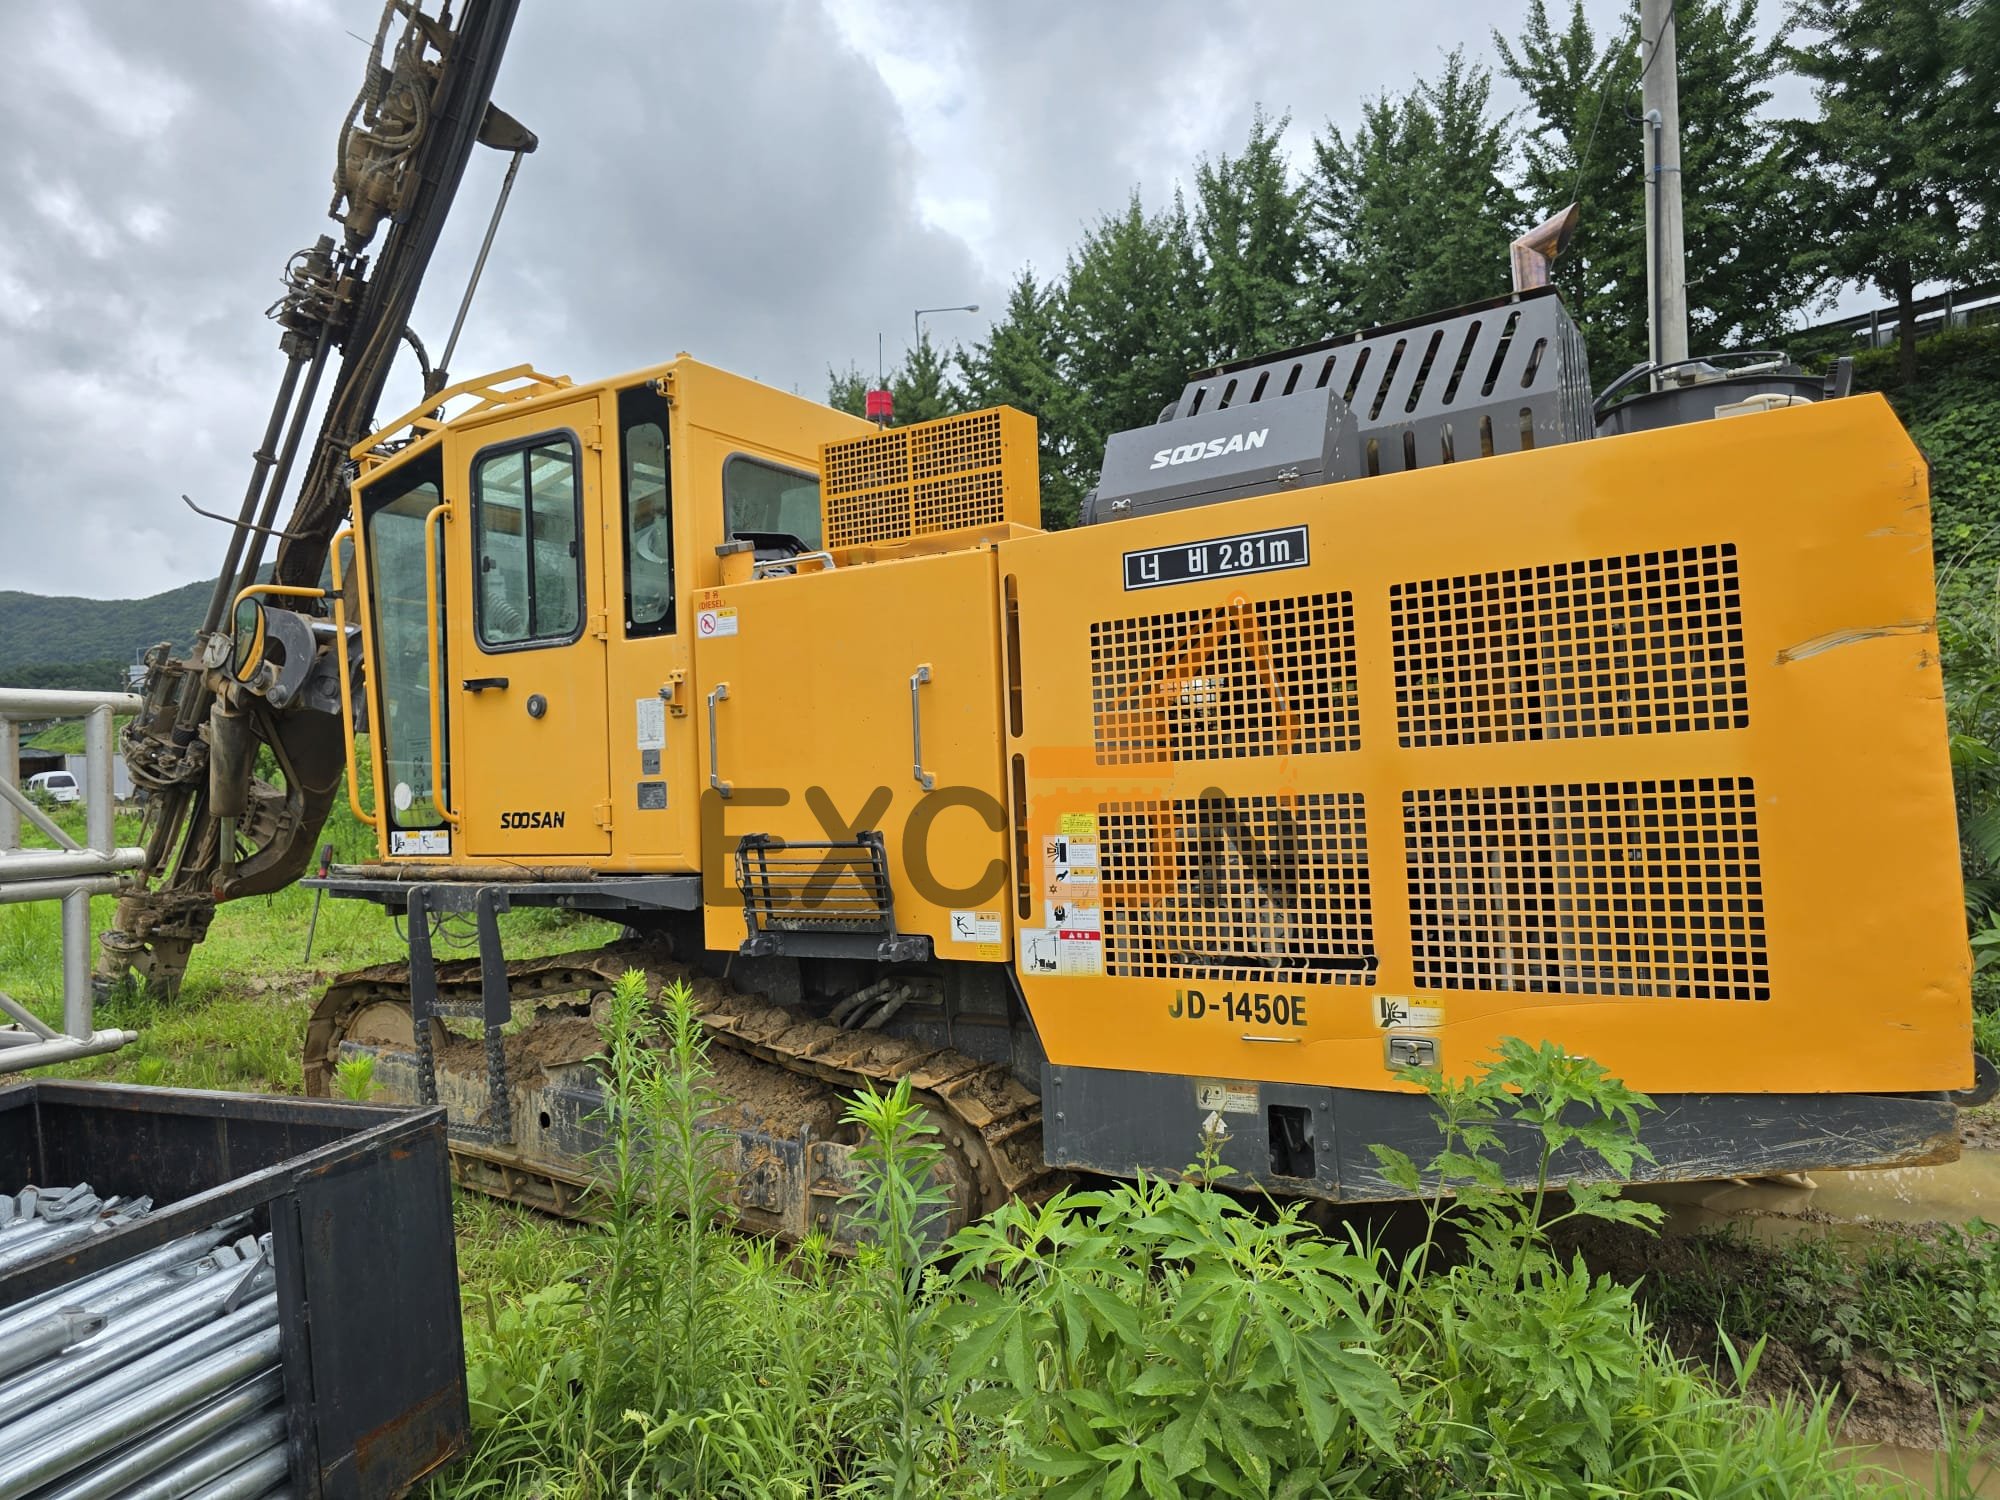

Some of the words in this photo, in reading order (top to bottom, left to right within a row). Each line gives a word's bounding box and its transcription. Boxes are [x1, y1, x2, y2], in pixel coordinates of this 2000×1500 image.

[1150, 429, 1268, 469] SOOSAN
[1219, 539, 1290, 570] 2.81m
[500, 811, 565, 829] SOOSAN
[1168, 990, 1308, 1026] JD-1450E
